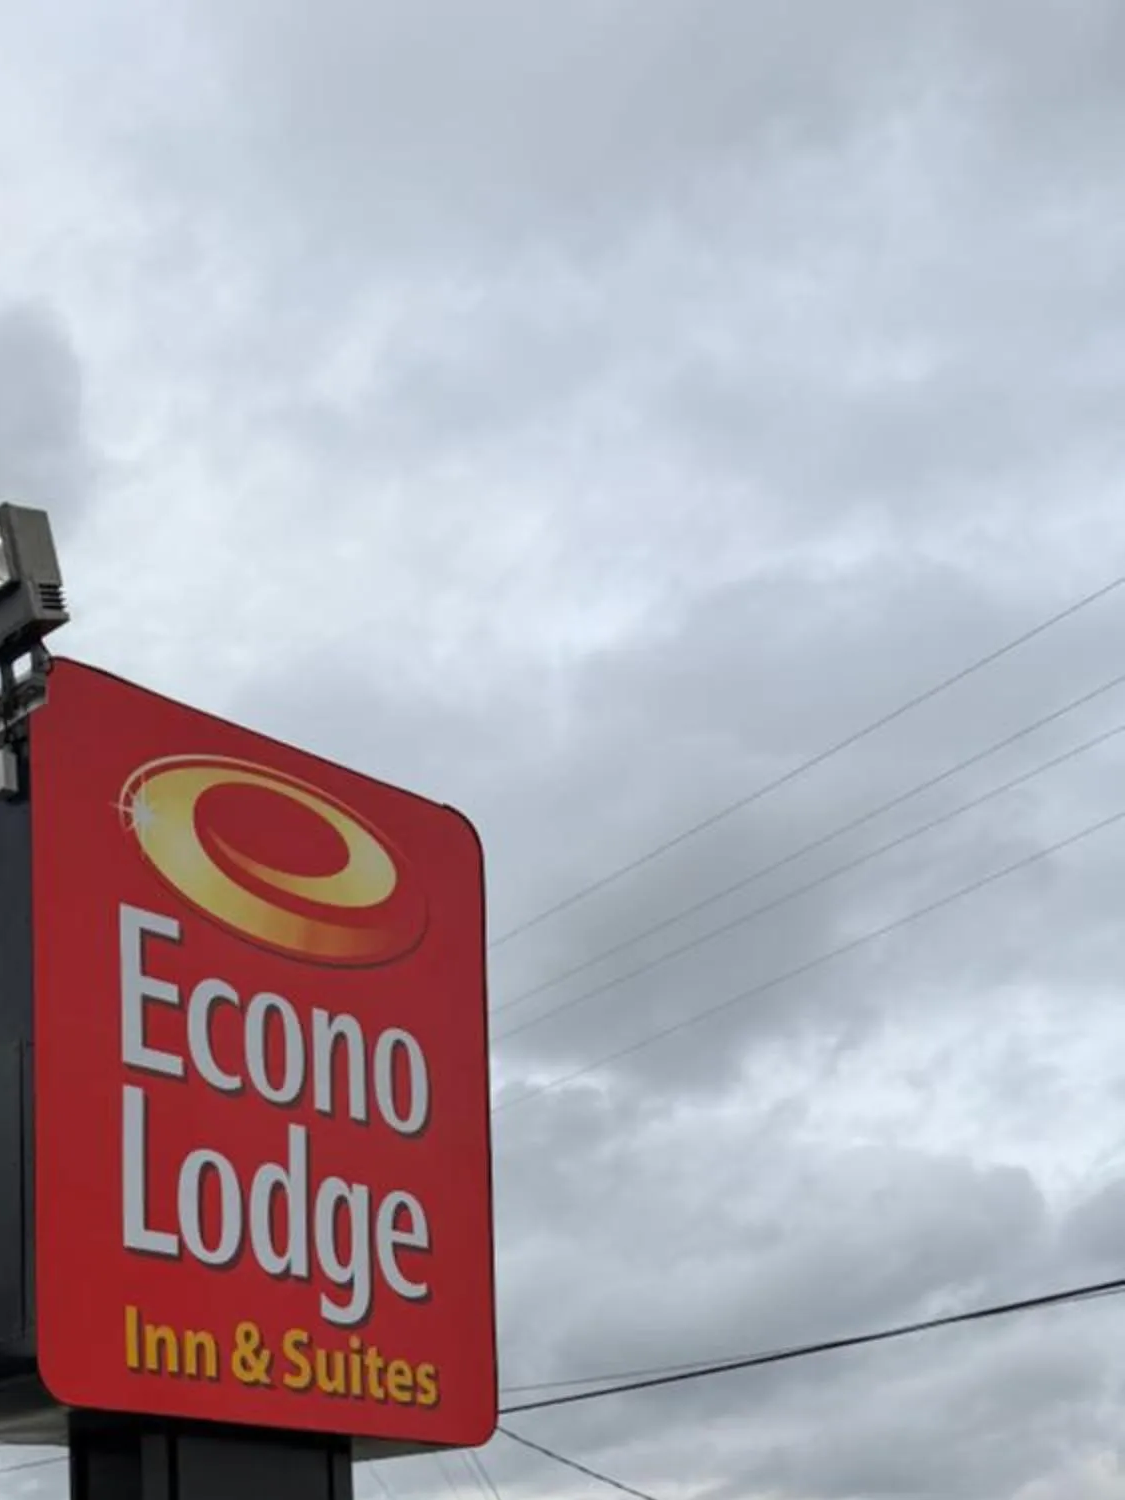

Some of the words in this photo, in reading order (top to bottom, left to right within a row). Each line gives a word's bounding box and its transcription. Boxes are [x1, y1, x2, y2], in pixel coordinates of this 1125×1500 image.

[119, 902, 429, 1134] Econo
[122, 1085, 429, 1324] Lodge
[124, 1305, 218, 1379] Inn
[232, 1320, 271, 1386] &
[282, 1328, 438, 1405] Suites
